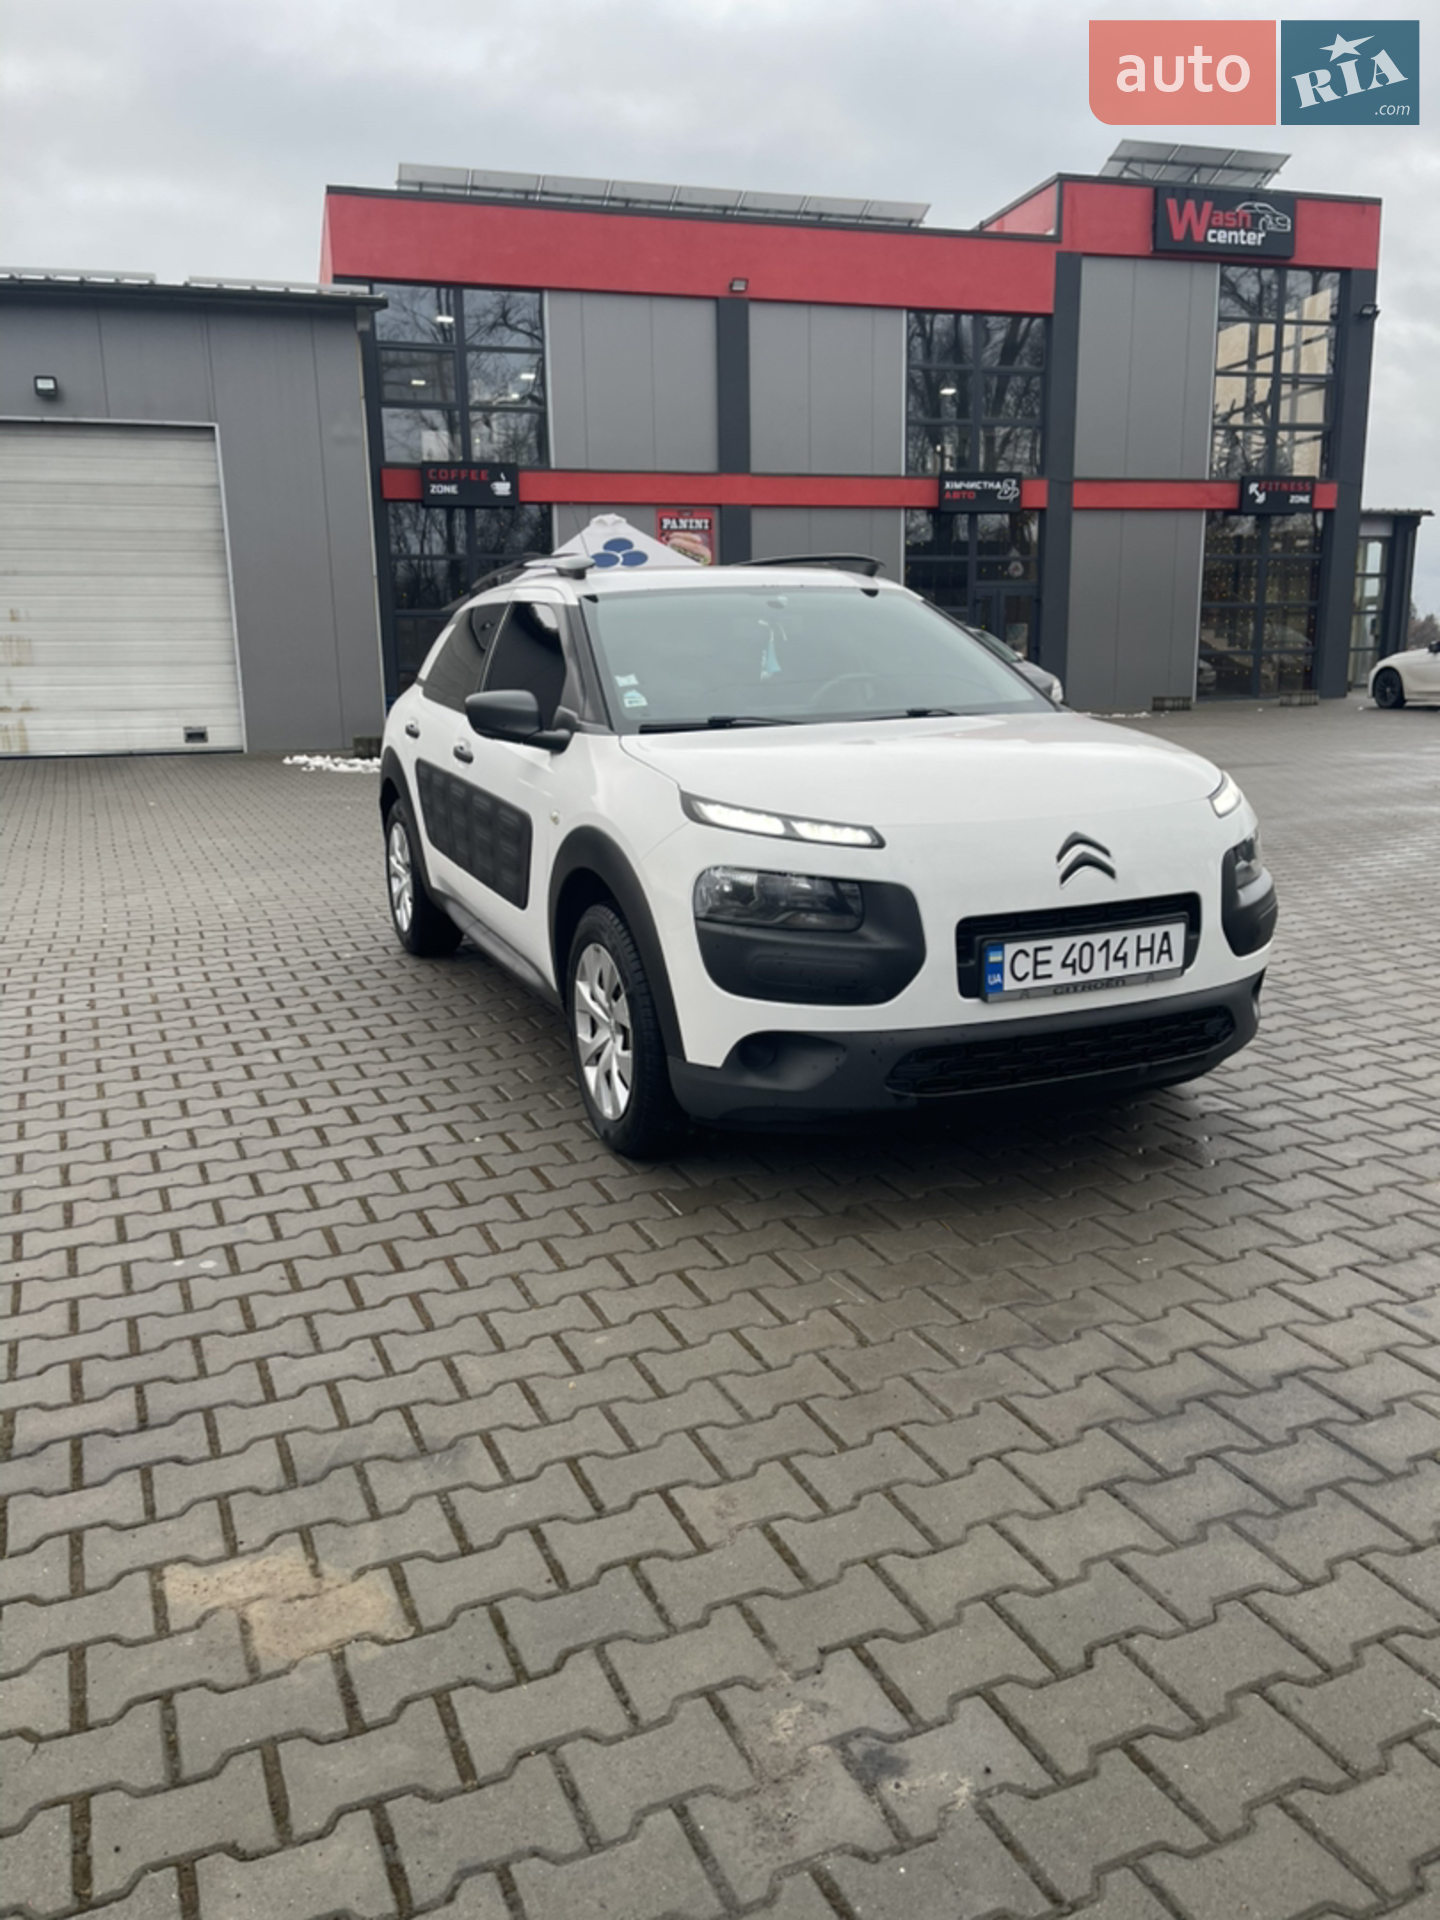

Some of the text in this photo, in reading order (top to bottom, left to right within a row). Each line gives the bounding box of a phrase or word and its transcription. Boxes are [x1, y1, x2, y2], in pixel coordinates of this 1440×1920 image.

[1166, 198, 1251, 243] Wash
[1207, 229, 1266, 246] center
[427, 468, 489, 481] COFFEE
[429, 483, 459, 495] ZONE
[662, 518, 710, 530] PANINI
[1009, 931, 1174, 982] CE 4014 HA
[987, 973, 1003, 985] UA
